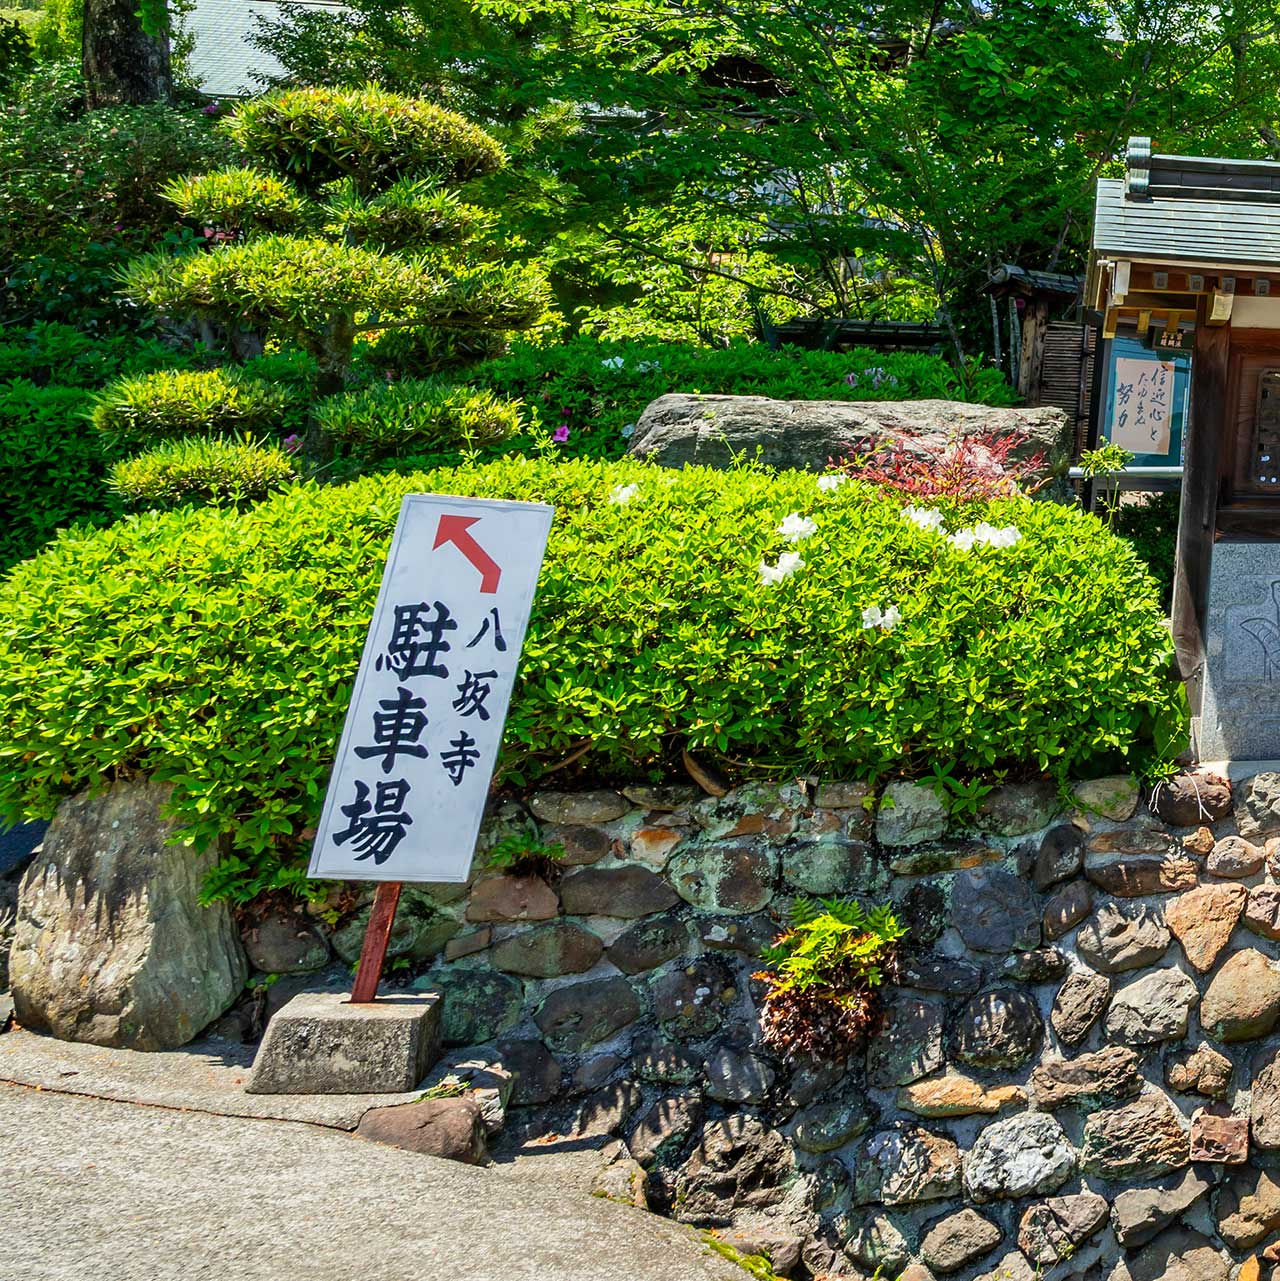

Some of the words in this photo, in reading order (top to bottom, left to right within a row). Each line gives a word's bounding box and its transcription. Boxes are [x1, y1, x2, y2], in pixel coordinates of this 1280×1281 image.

[1116, 382, 1134, 428] 努力
[331, 600, 458, 866] 駐車場
[440, 606, 507, 787] 八坂寺
